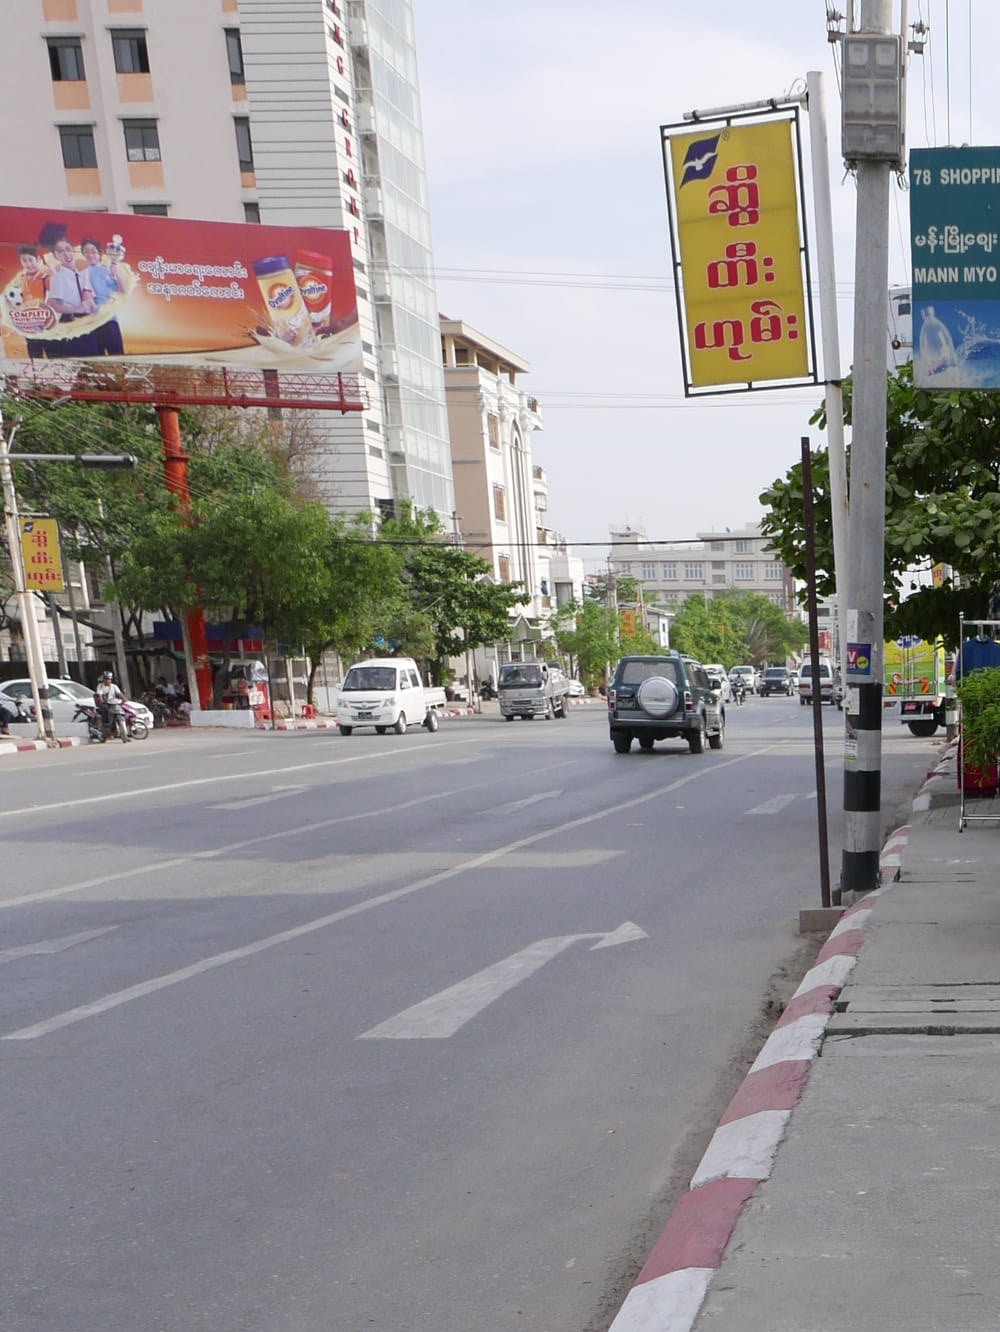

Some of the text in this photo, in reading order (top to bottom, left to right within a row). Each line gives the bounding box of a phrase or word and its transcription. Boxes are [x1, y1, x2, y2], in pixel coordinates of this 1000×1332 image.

[913, 169, 932, 186] 78
[914, 267, 959, 283] MANN
[963, 266, 997, 282] MYO
[267, 285, 294, 309] Ovaltine
[9, 310, 50, 318] COMPLETE
